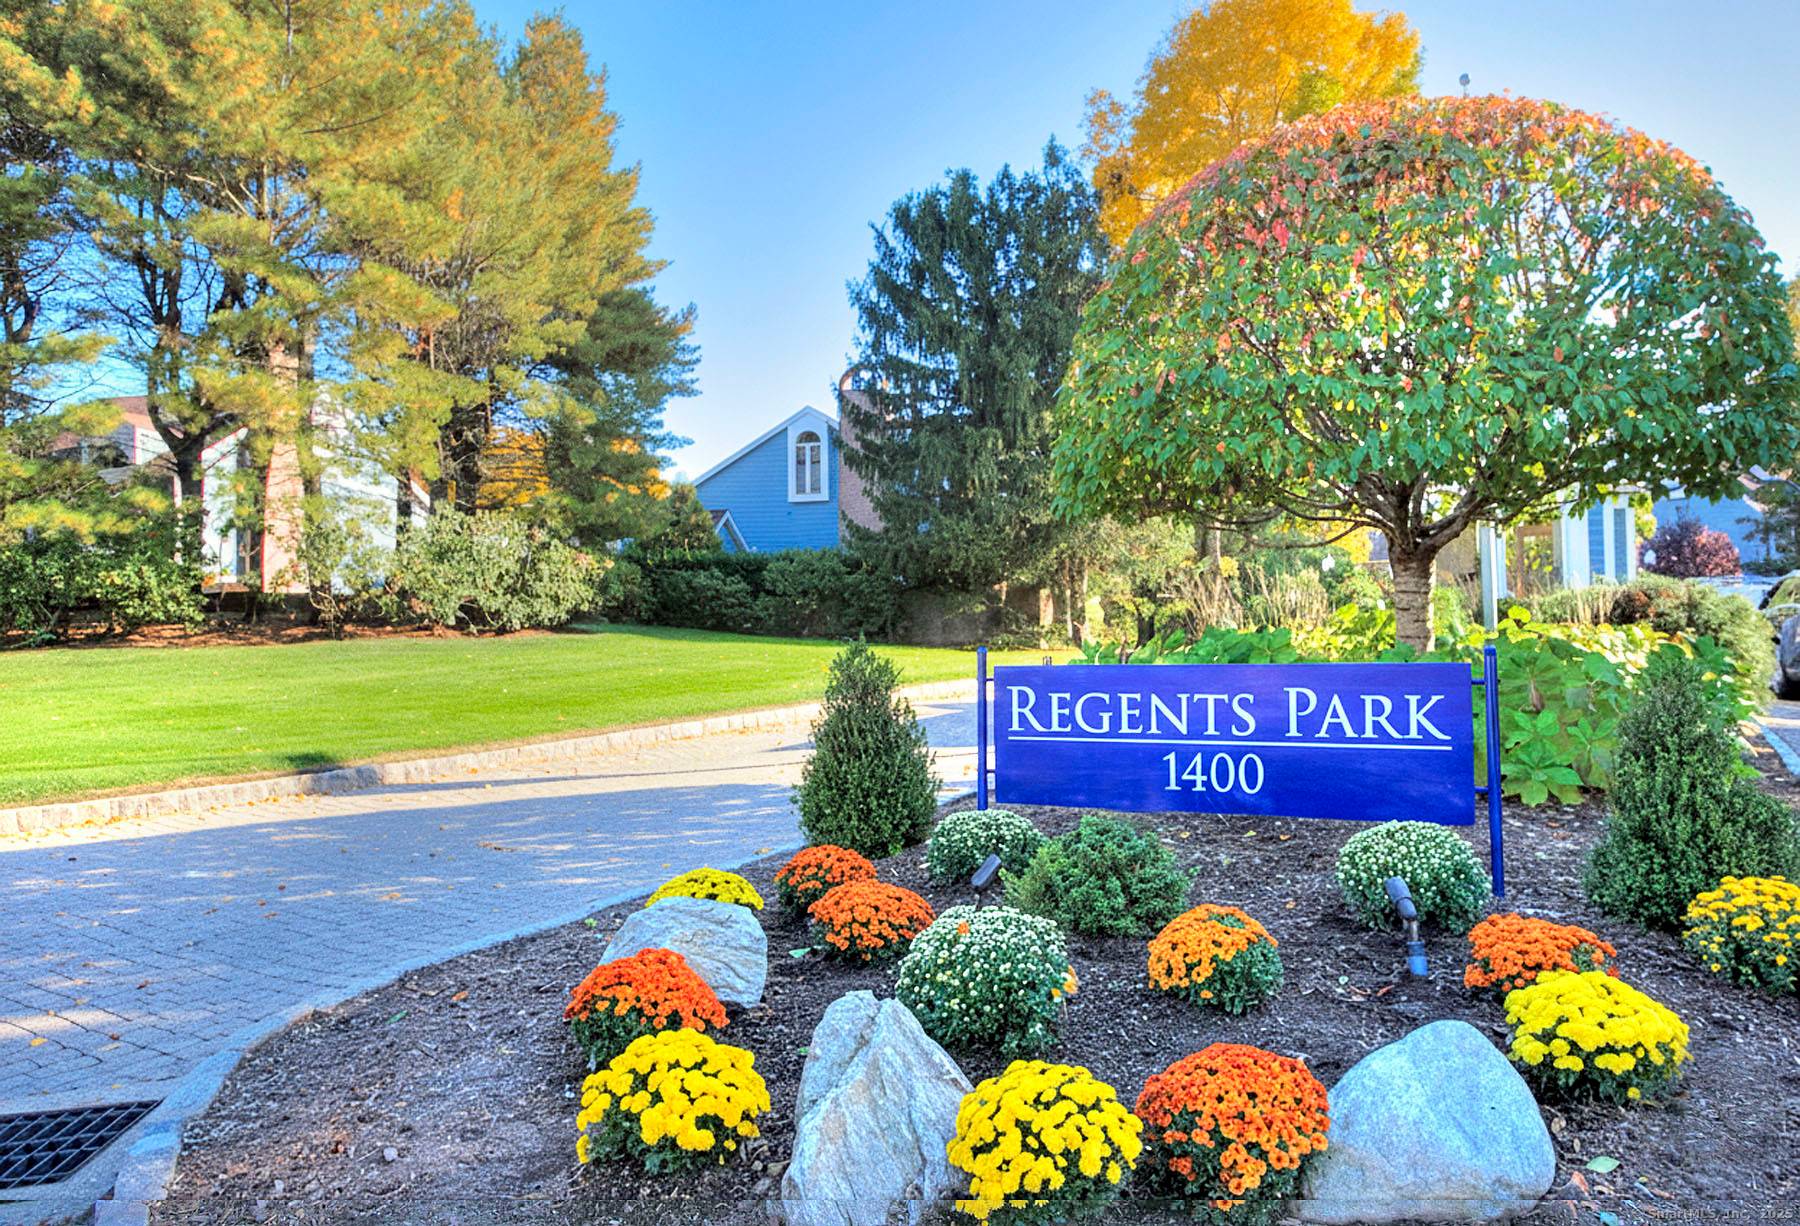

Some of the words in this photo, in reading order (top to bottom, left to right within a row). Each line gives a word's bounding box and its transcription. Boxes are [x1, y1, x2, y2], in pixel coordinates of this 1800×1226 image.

[1007, 685, 1256, 737] REGENTS
[1284, 687, 1452, 740] PARK
[1163, 751, 1264, 794] 1400
